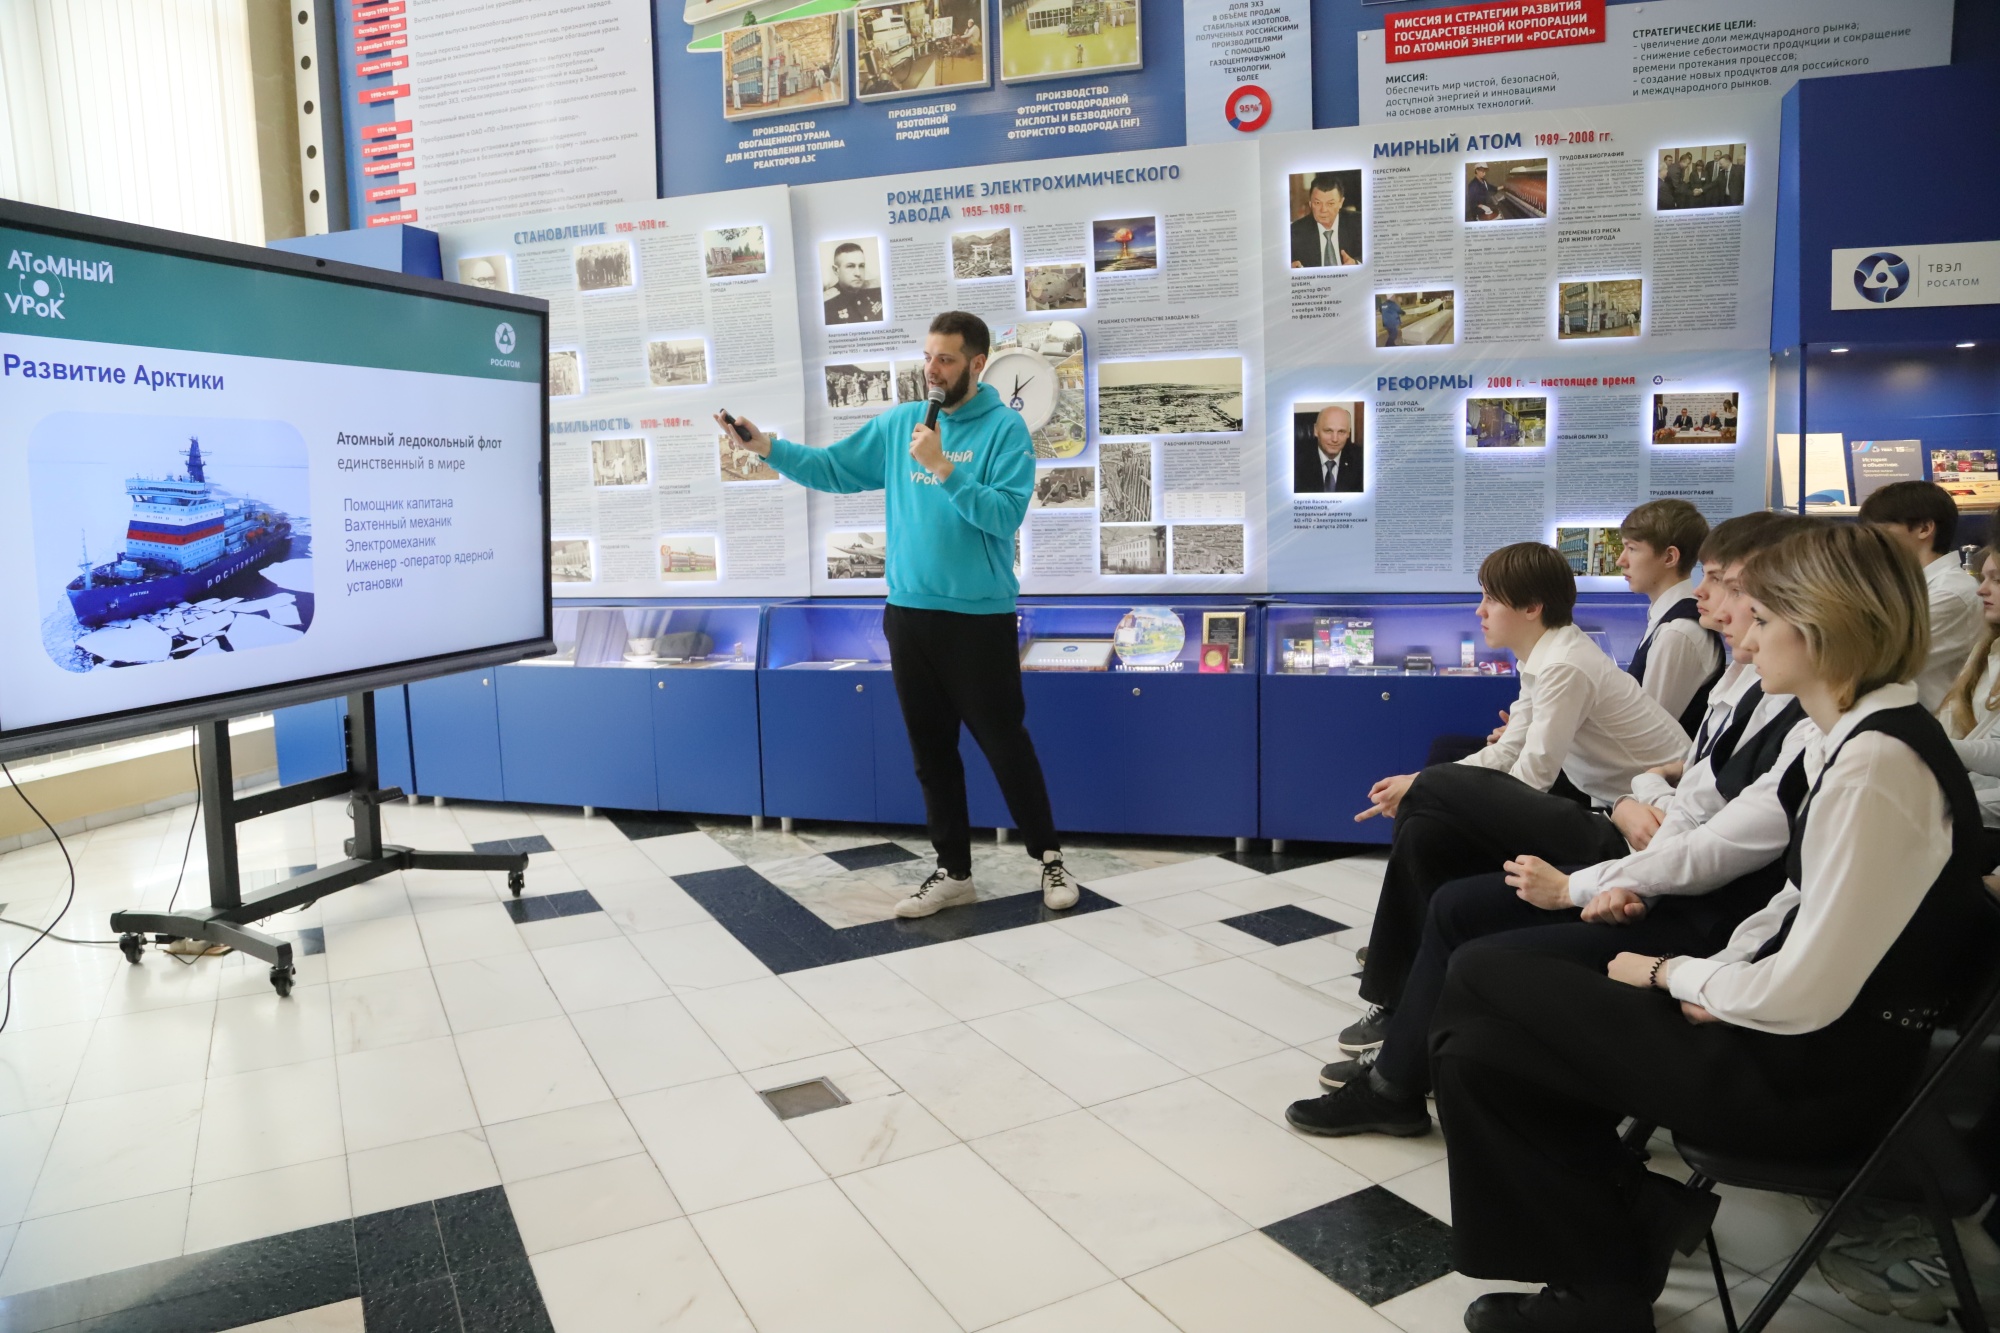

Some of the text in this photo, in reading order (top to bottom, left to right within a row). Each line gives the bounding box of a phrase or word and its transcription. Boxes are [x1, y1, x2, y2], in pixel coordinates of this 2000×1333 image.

[1229, 2, 1248, 11] ДОЛЯ
[1250, 7, 1280, 17] ПРОДАЖ
[1395, 1, 1581, 28] МИССИЯ И СТРАТЕГИИ РАЗВИТИЯ
[1203, 16, 1291, 31] СТАБИЛЬНЫХ ИЗОТОПОВ,
[1395, 14, 1587, 42] ГОСУДАРСТВЕННОЙ КОРПОРАЦИИ
[1633, 20, 1756, 38] СТРАТЕГИЧЕСКИЕ ЦЕЛИ:
[1196, 24, 1298, 41] ПОЛУЧЕННЫХ РОССИЙСКИМИ
[1395, 27, 1595, 55] ПО АТОМНОЙ ЭНЕРГИИ «РОСАТОМ»
[1641, 23, 1859, 51] увеличение доли международного рынка;
[1212, 35, 1282, 48] ПРОИЗВОДИТЕЛЯМИ
[1231, 45, 1270, 55] ПОМОЩЬЮ
[1641, 50, 1690, 61] снижение
[1693, 42, 1770, 56] себестоимости
[1773, 37, 1830, 49] продукции
[1843, 29, 1911, 41] сокращение
[1210, 51, 1285, 66] ГАЗОЦЕНТРИФУЖНОЙ
[1633, 54, 1797, 74] времени протекания процессов;
[1224, 64, 1271, 74] ТЕХНОЛОГИИ,
[1641, 58, 1868, 84] создание новых продуктов для российского
[1386, 73, 1428, 84] МИССИЯ:
[1386, 73, 1559, 95] Обеспечить мир чистой, безопасной,
[1036, 86, 1108, 101] ПРОИЗВОДСТВО
[1386, 94, 1434, 107] доступной
[1437, 90, 1479, 102] энергией
[1491, 86, 1555, 97] инновациями
[1642, 83, 1727, 96] международного
[1731, 80, 1771, 91] рынков.
[889, 104, 956, 119] ПРОИЗВОДСТВО
[1018, 94, 1128, 114] ФТОРИСТОВОДОРОДНОЙ
[1399, 107, 1431, 116] основе
[1434, 103, 1474, 113] атомных
[1477, 97, 1533, 109] технологий.
[897, 114, 948, 129] ИЗОТОПНОЙ
[1016, 108, 1131, 127] КИСЛОТЫ И БЕЗВОДНОГО
[753, 122, 815, 136] ПРОИЗВОДСТВО
[896, 127, 949, 140] ПРОДУКЦИИ
[1008, 119, 1139, 139] ФТОРИСТОГО ВОДОРОДА (HF)
[739, 130, 830, 149] ОБОГАЩЕННОГО УРАНА
[1373, 134, 1458, 159] МИРНЫЙ
[1467, 133, 1521, 151] АТОМ
[726, 140, 845, 163] ДЛЯ ИЗГОТОВЛЕНИЯ ТОПЛИВА
[754, 154, 815, 169] РЕАКТОРОВ АЭС
[1373, 166, 1410, 174] ПЕРЕСТРОЙКА
[887, 165, 1179, 206] РОЖДЕНИЕ ЭЛЕКТРОХИМИЧЕСКОГО
[889, 206, 950, 224] ЗАВОДА
[514, 221, 607, 245] СТАНОВЛЕНИЕ
[1928, 263, 1961, 272] ТВЭЛ
[1927, 278, 1979, 287] РОСАТОМ
[490, 358, 520, 368] РОСАТОМ
[4, 353, 224, 391] Развитие Арктики
[1377, 374, 1473, 391] РЕФОРМЫ
[1488, 377, 1511, 388] 2008
[1541, 377, 1598, 387] настоящее
[1602, 376, 1635, 387] время
[549, 418, 631, 434] АБИЛЬНОСТЬ
[337, 432, 502, 451] Атомный ледокольный флот
[337, 456, 465, 472] единственный в мире
[344, 498, 454, 512] Помощник капитана
[344, 517, 452, 532] Вахтенный механик
[345, 536, 436, 553] Электромеханик
[346, 549, 494, 572] Инженер -оператор ядерной
[347, 577, 403, 596] установки
